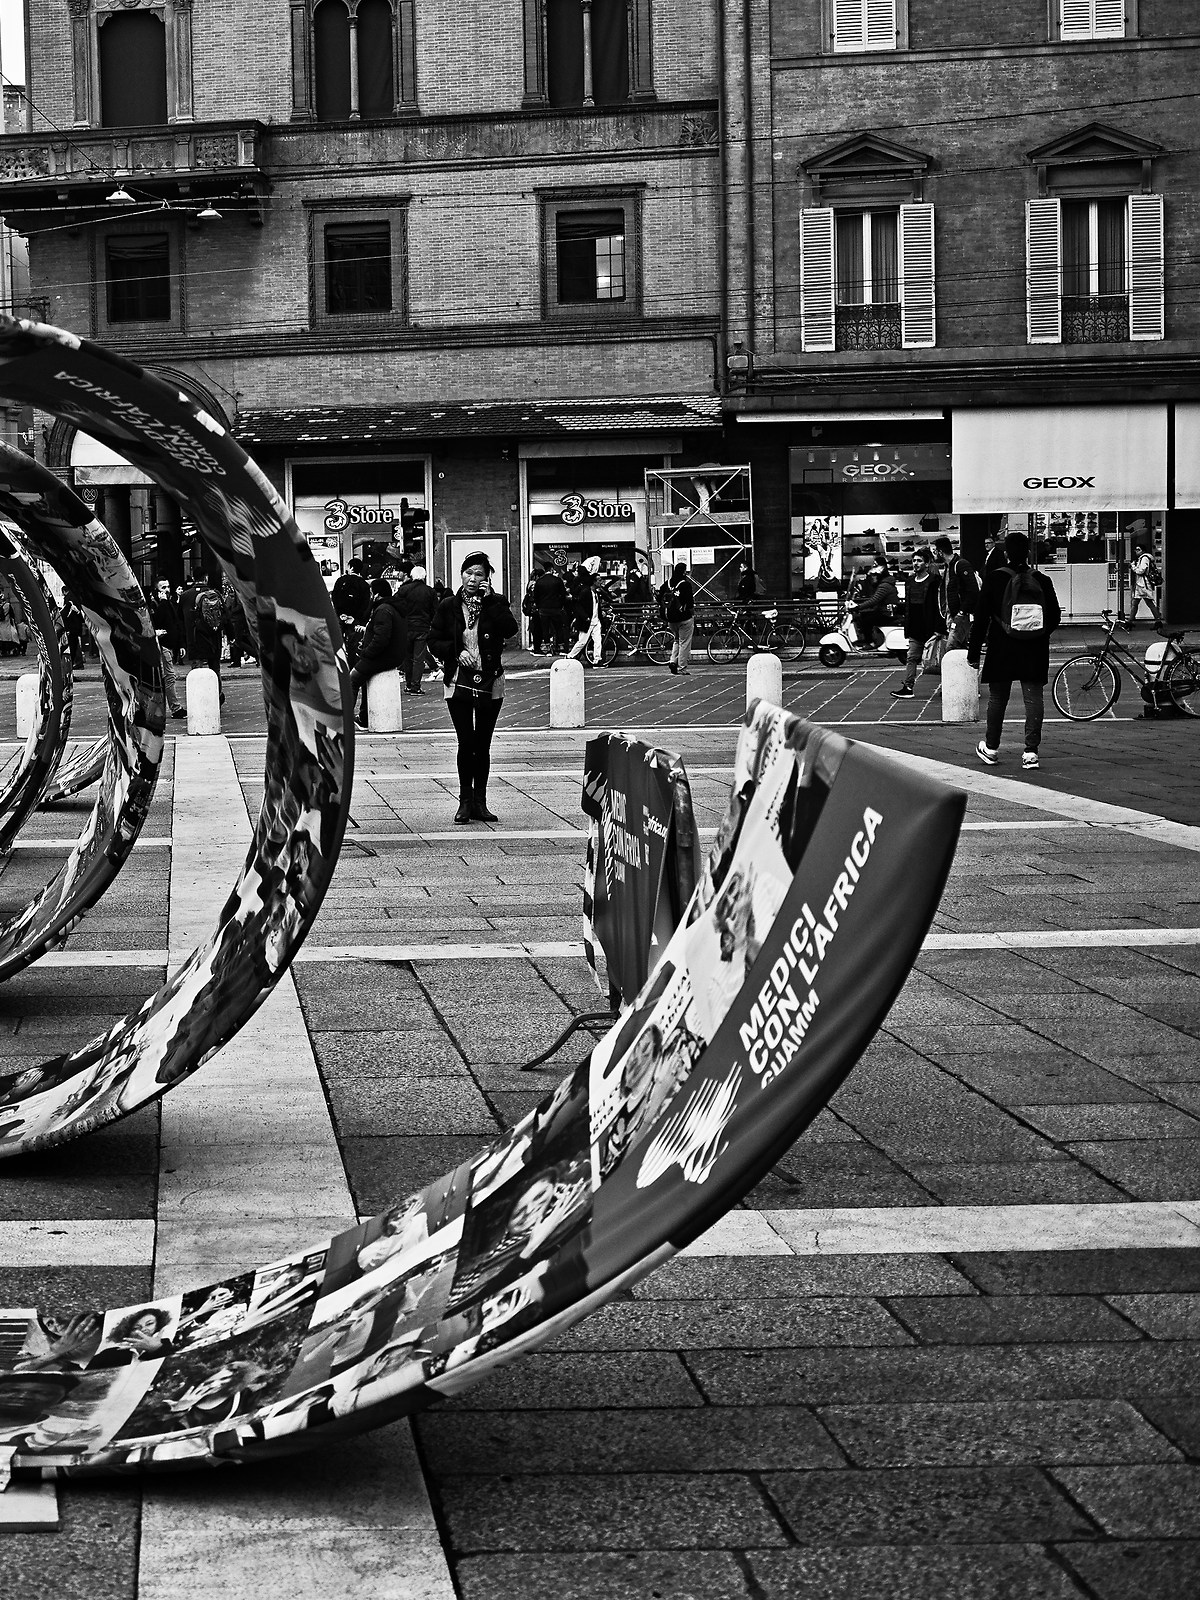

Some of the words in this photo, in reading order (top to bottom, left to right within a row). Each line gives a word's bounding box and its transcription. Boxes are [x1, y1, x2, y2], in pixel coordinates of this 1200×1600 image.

[111, 410, 197, 471] MEDICI
[163, 432, 213, 475] CON
[170, 424, 227, 477] CUAMM
[842, 463, 908, 477] GEOX
[1022, 476, 1096, 490] GEOX
[350, 506, 394, 524] Store
[586, 502, 633, 519] Store
[749, 983, 800, 1075] CON
[798, 806, 884, 986] L'AFRICA
[738, 902, 817, 1052] MEDICI
[760, 988, 821, 1090] CUAMM
